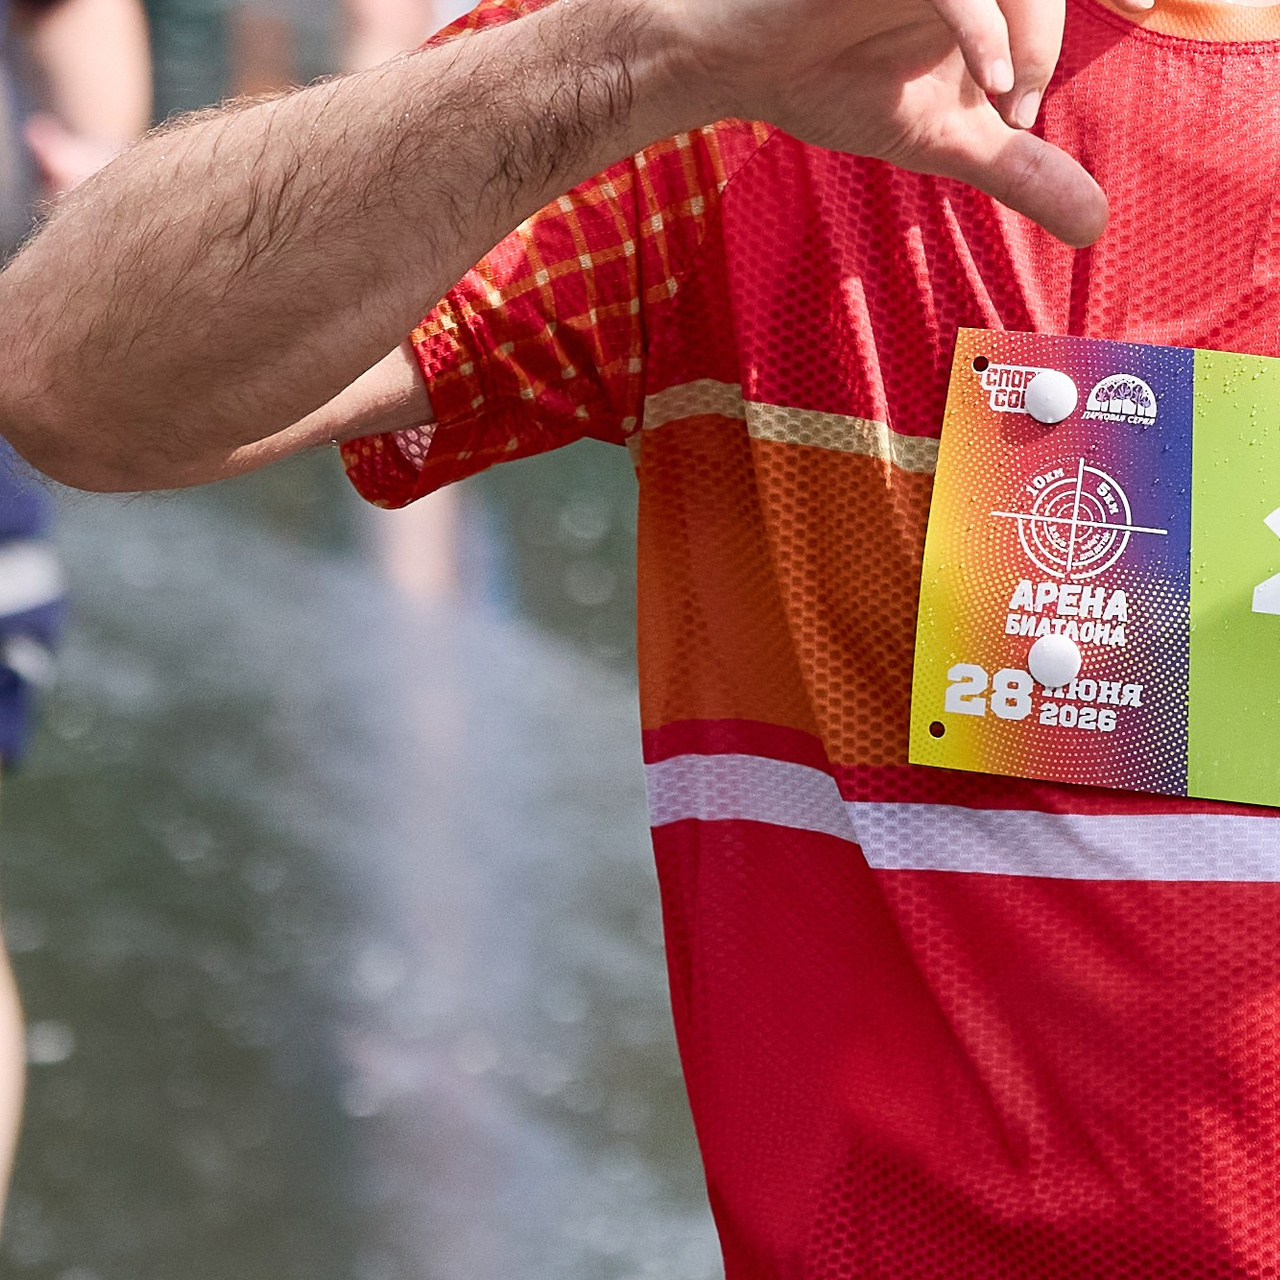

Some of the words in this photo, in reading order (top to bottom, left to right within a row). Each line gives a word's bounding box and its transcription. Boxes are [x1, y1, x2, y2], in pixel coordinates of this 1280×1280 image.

[985, 368, 1042, 389] СПОР
[1127, 416, 1156, 426] СЕРИЯ
[1008, 579, 1129, 623] АРЕНА
[1005, 613, 1126, 647] БИАТЛОНА
[944, 662, 1034, 721] 28
[1039, 701, 1117, 732] 2026
